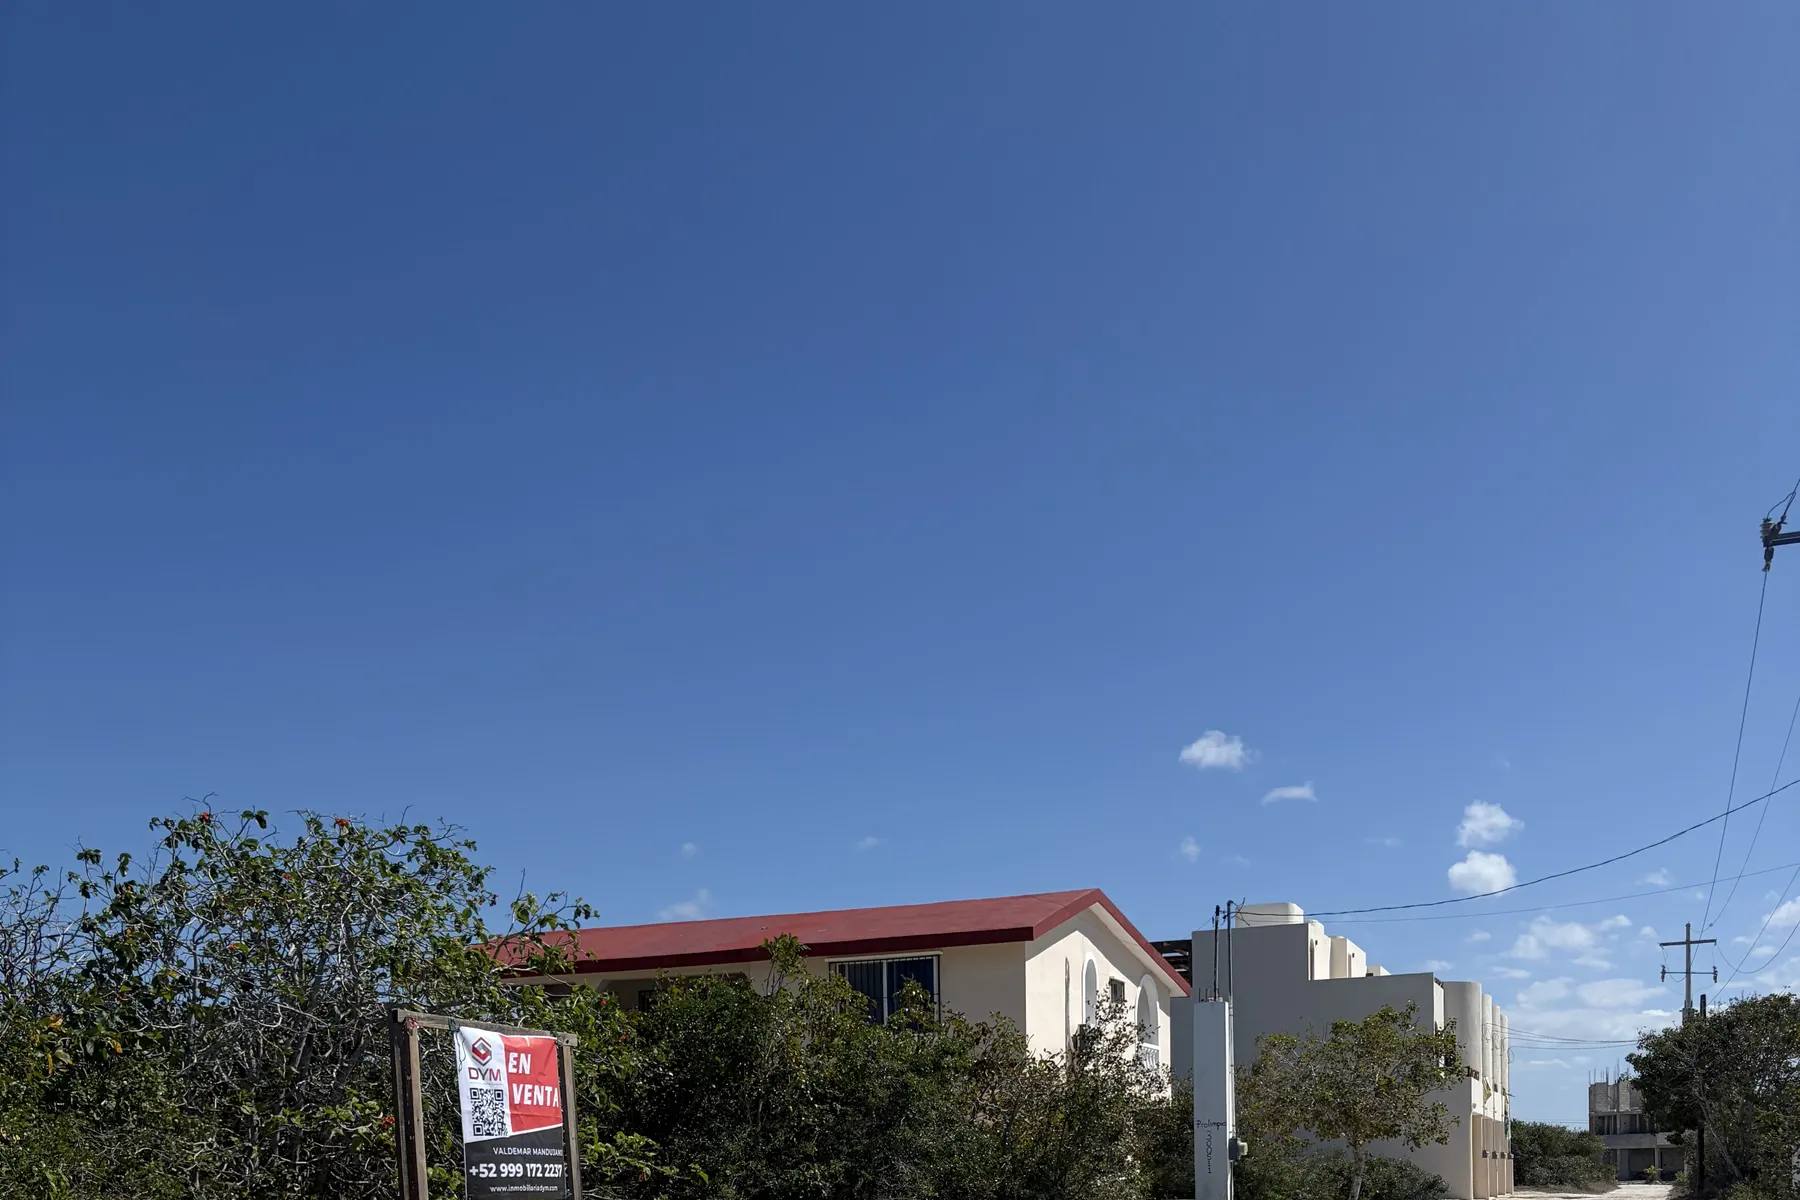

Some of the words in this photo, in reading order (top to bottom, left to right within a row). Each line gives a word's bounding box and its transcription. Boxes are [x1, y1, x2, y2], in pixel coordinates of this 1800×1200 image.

[508, 1052, 531, 1074] EN
[468, 1067, 501, 1081] DYM
[512, 1083, 559, 1107] VENTA
[493, 1147, 531, 1155] VALDEMAR
[469, 1163, 497, 1178] +52
[500, 1163, 523, 1178] 999
[525, 1164, 543, 1178] 172
[544, 1164, 562, 1178] 2237
